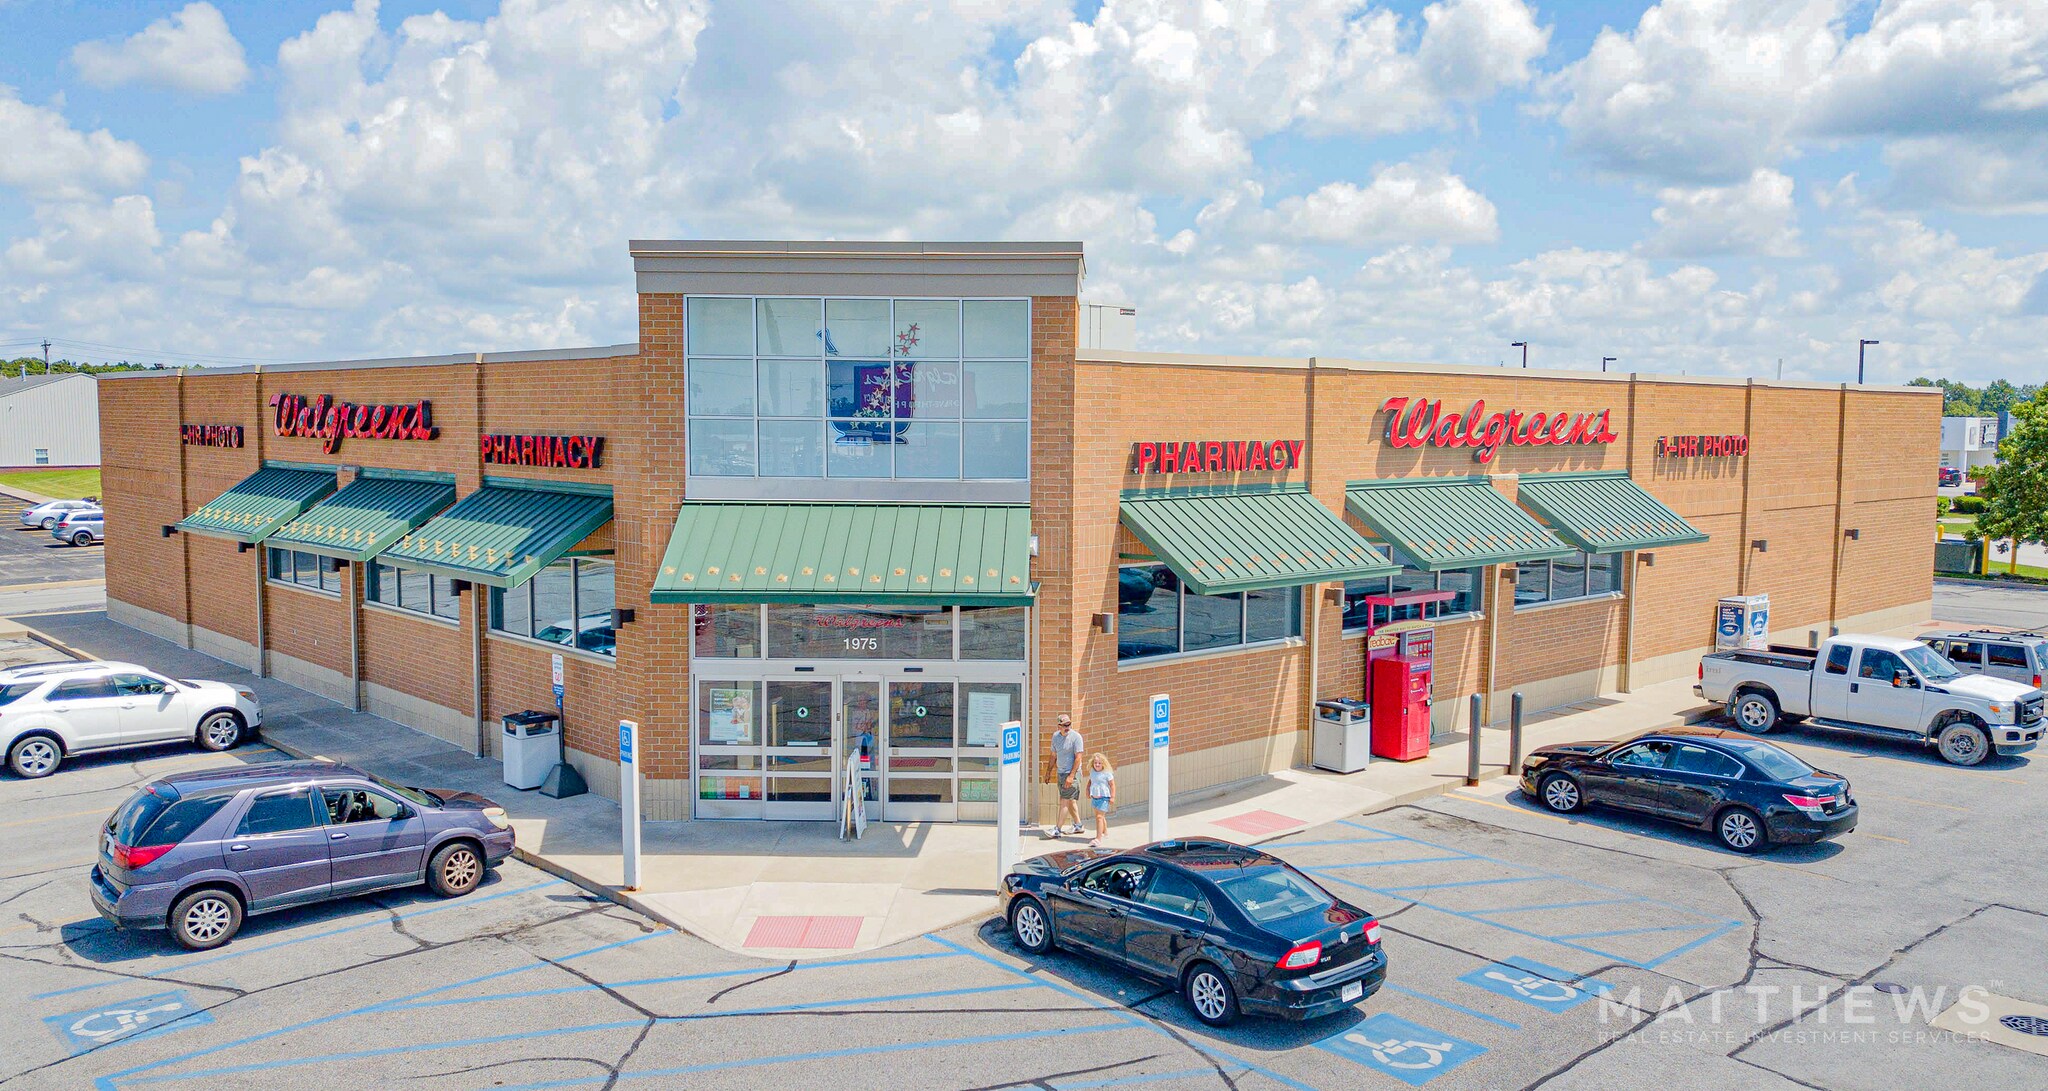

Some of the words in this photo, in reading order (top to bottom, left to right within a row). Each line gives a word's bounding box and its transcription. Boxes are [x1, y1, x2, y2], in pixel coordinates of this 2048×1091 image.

[204, 425, 239, 448] PHOTO
[269, 393, 437, 455] Walgreens
[1381, 396, 1619, 464] Walgreens
[481, 434, 601, 469] PHARMACY
[1138, 439, 1305, 474] PHARMACY
[1659, 436, 1698, 458] 1-HR
[1703, 435, 1749, 457] PHOTO
[816, 614, 905, 632] Walgreens
[843, 637, 878, 651] 1975
